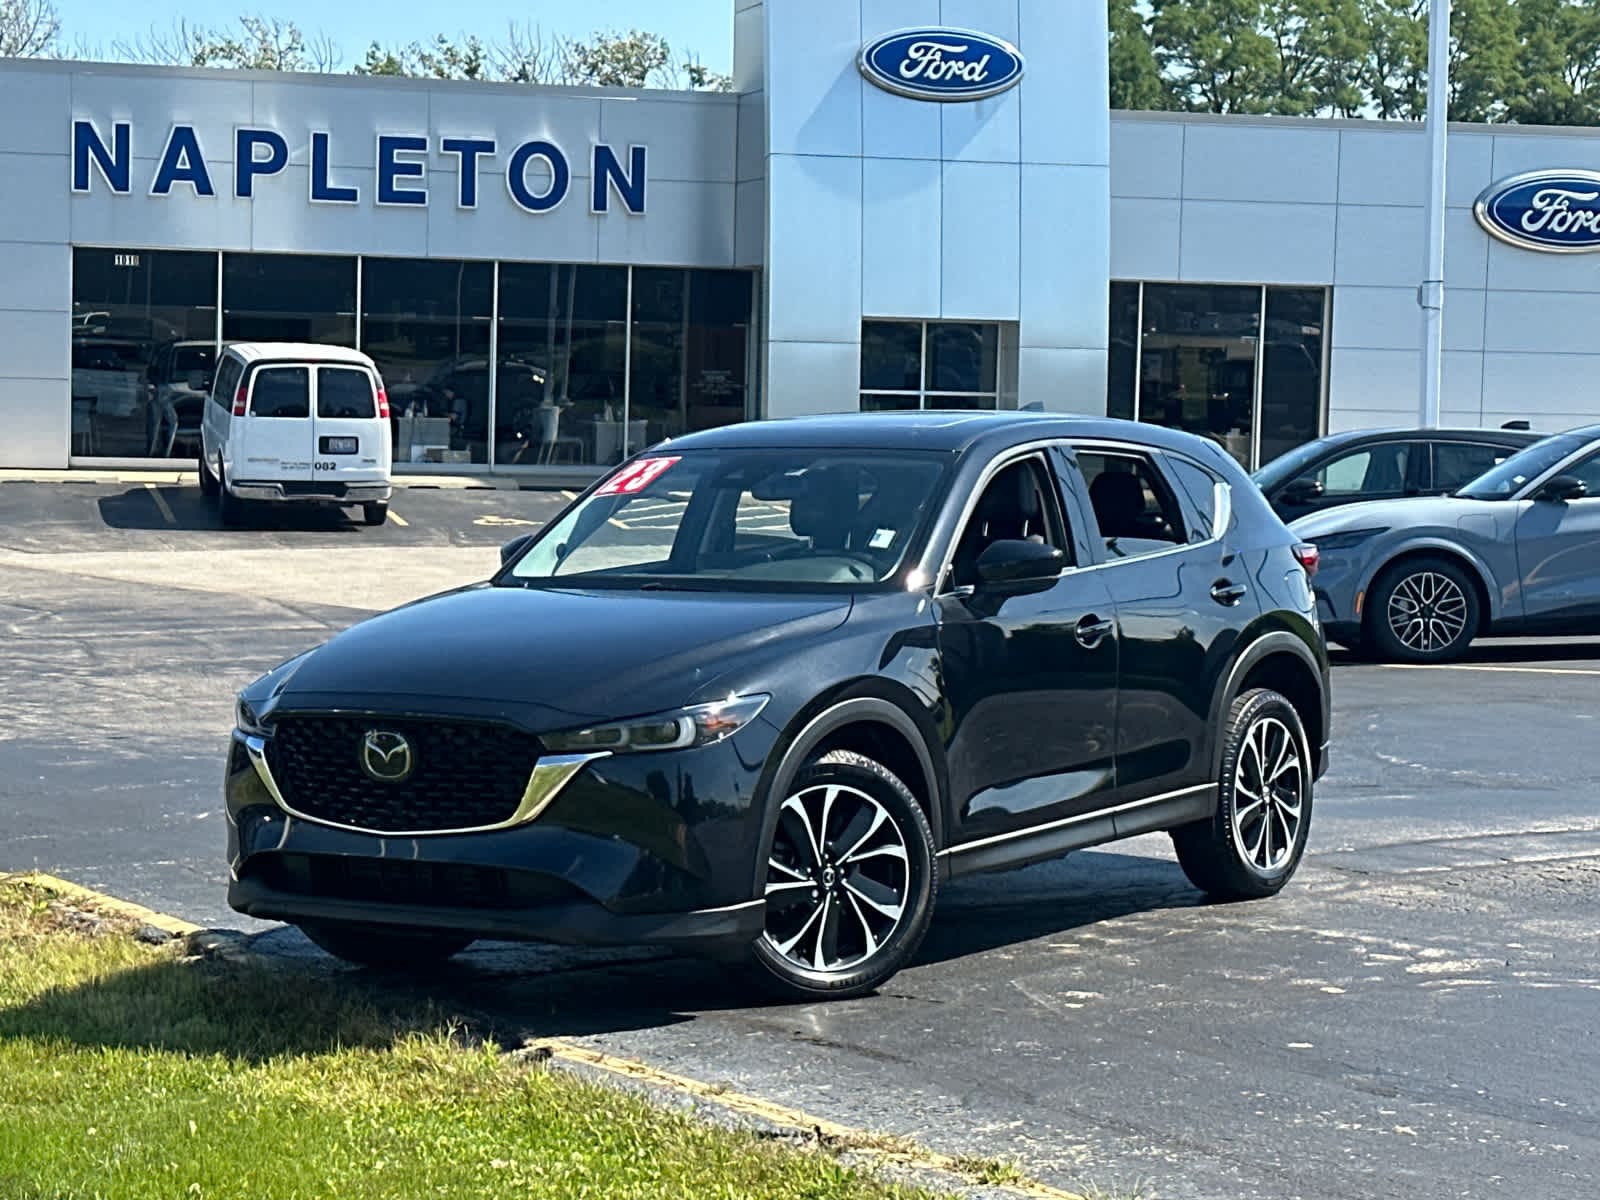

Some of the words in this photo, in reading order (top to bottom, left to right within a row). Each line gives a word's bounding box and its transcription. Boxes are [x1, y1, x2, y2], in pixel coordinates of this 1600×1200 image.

[899, 41, 991, 82] Ford
[72, 118, 646, 215] NAPLETON
[314, 461, 337, 471] 082
